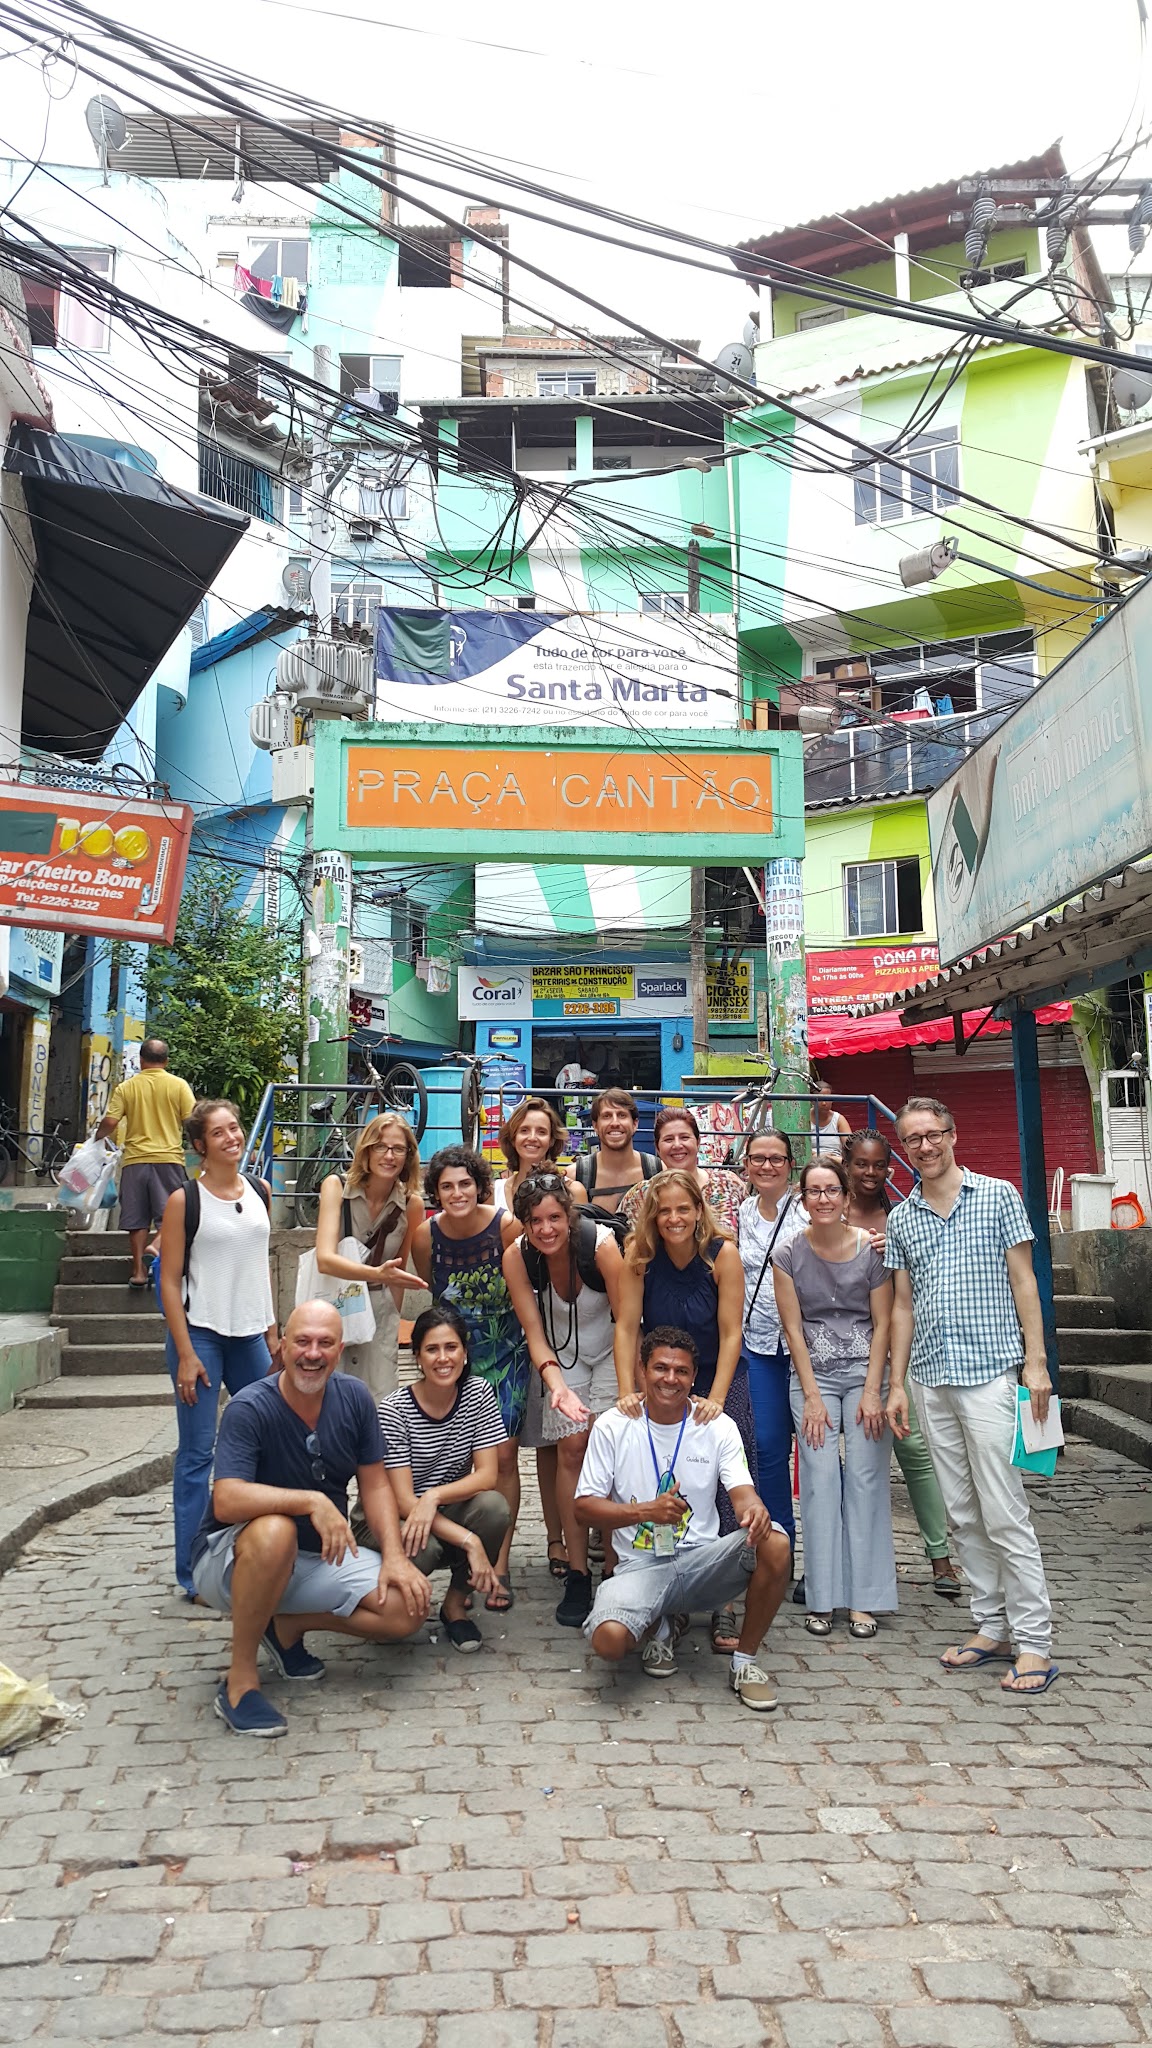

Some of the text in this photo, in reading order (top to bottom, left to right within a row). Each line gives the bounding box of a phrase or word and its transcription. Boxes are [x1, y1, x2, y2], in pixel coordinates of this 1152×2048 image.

[536, 645, 686, 659] Tudo de cor para você
[534, 662, 553, 670] está
[556, 663, 596, 671] trazendo
[599, 663, 614, 671] cor
[625, 662, 655, 672] alegria
[659, 663, 679, 672] para
[507, 674, 708, 702] Santa Marta
[482, 706, 497, 714] (21)
[499, 707, 541, 715] 3226-7242
[1012, 692, 1134, 822] BAR DO MANOEL
[357, 769, 761, 815] PRAÇA CANTÃO
[0, 857, 23, 874] ar
[24, 860, 93, 884] Cheiro
[93, 869, 142, 890] Bom
[772, 860, 800, 876] GENTE
[60, 884, 69, 893] e
[69, 882, 124, 900] Lanches
[16, 892, 100, 911] Tel.: 2226-3232
[872, 950, 917, 969] DONA
[532, 965, 633, 977] BAZAR SÃO FRANCISCO
[818, 966, 857, 974] Diariamente
[875, 967, 910, 976] PIZZARIA
[532, 978, 571, 986] MATERIAIS
[578, 975, 628, 986] CONSTRUÇÃO
[472, 986, 516, 1001] Coral
[640, 982, 683, 994] Sparlack
[707, 996, 749, 1007] UNISSEX
[812, 995, 854, 1005] ENTREGA
[564, 1002, 616, 1015] 2226-3195
[28, 1044, 47, 1155] BONECO
